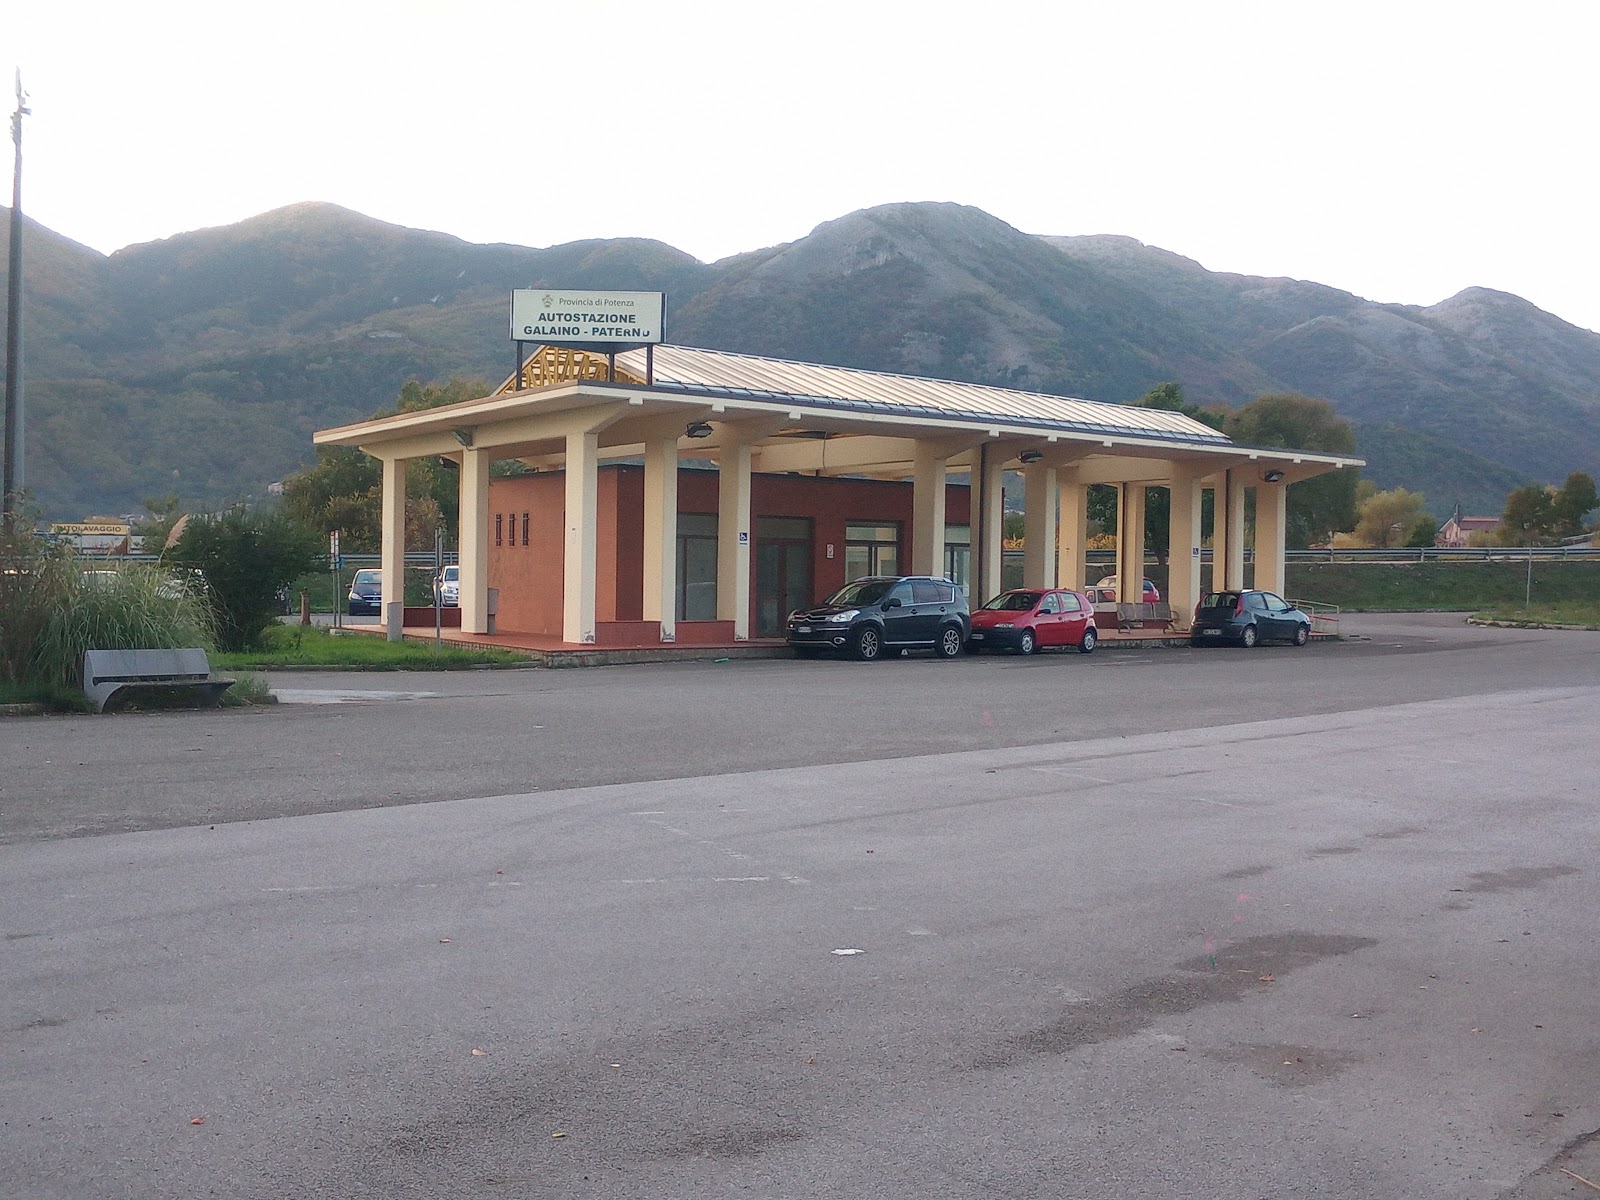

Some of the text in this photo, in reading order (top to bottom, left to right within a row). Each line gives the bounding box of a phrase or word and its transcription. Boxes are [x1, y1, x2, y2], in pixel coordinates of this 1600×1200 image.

[558, 298, 593, 306] Provincia
[604, 299, 634, 307] Potenza
[538, 313, 636, 323] AUTOSTAZIONE
[524, 326, 580, 336] GALAINO
[56, 525, 122, 533] TOLAVAGGIO
